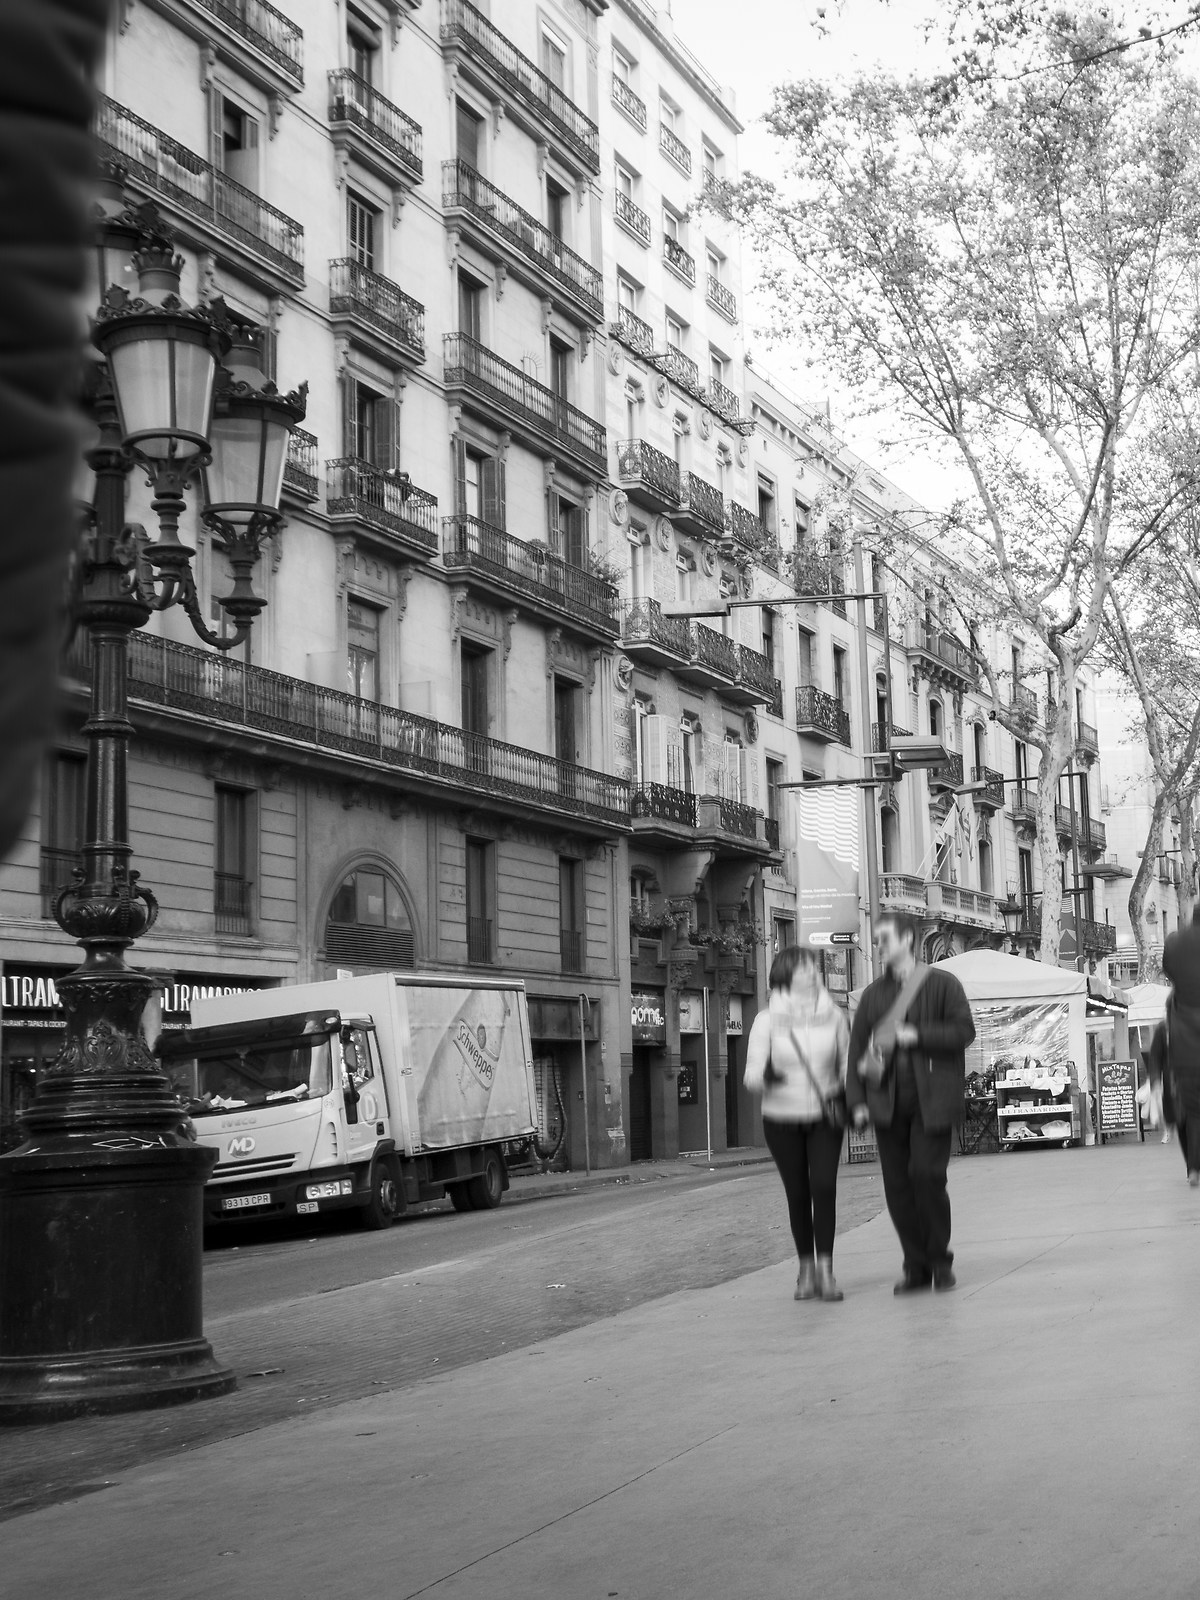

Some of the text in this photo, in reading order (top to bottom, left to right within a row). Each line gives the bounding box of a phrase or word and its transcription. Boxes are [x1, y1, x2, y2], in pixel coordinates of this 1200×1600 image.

[1001, 1106, 1068, 1114] ULTRAMARINOS
[221, 1117, 257, 1128] IVECO
[227, 1195, 269, 1208] 9313 CPR
[299, 1203, 317, 1213] SP
